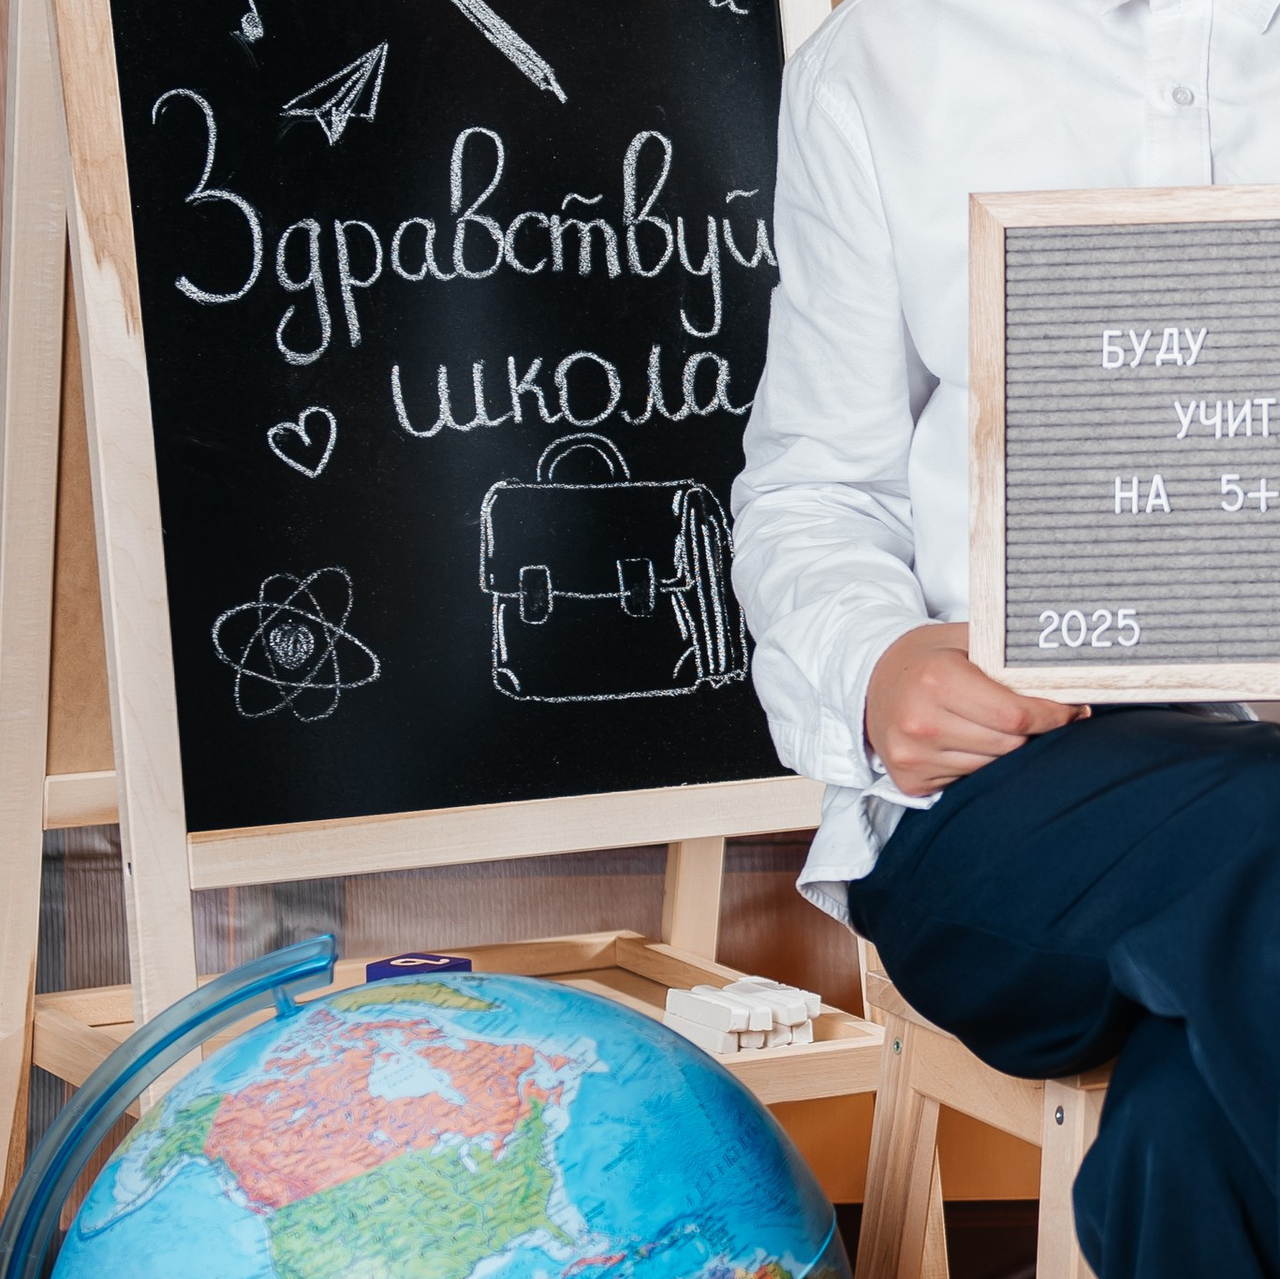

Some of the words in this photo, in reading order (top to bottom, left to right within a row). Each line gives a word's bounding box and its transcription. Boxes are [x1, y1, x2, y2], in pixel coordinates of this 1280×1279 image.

[152, 88, 777, 366] Здравствуй
[1101, 327, 1208, 369] БУДУ
[391, 345, 755, 438] школа
[1113, 474, 1172, 514] НА
[1220, 474, 1280, 513] 5+
[1037, 609, 1141, 648] 2025
